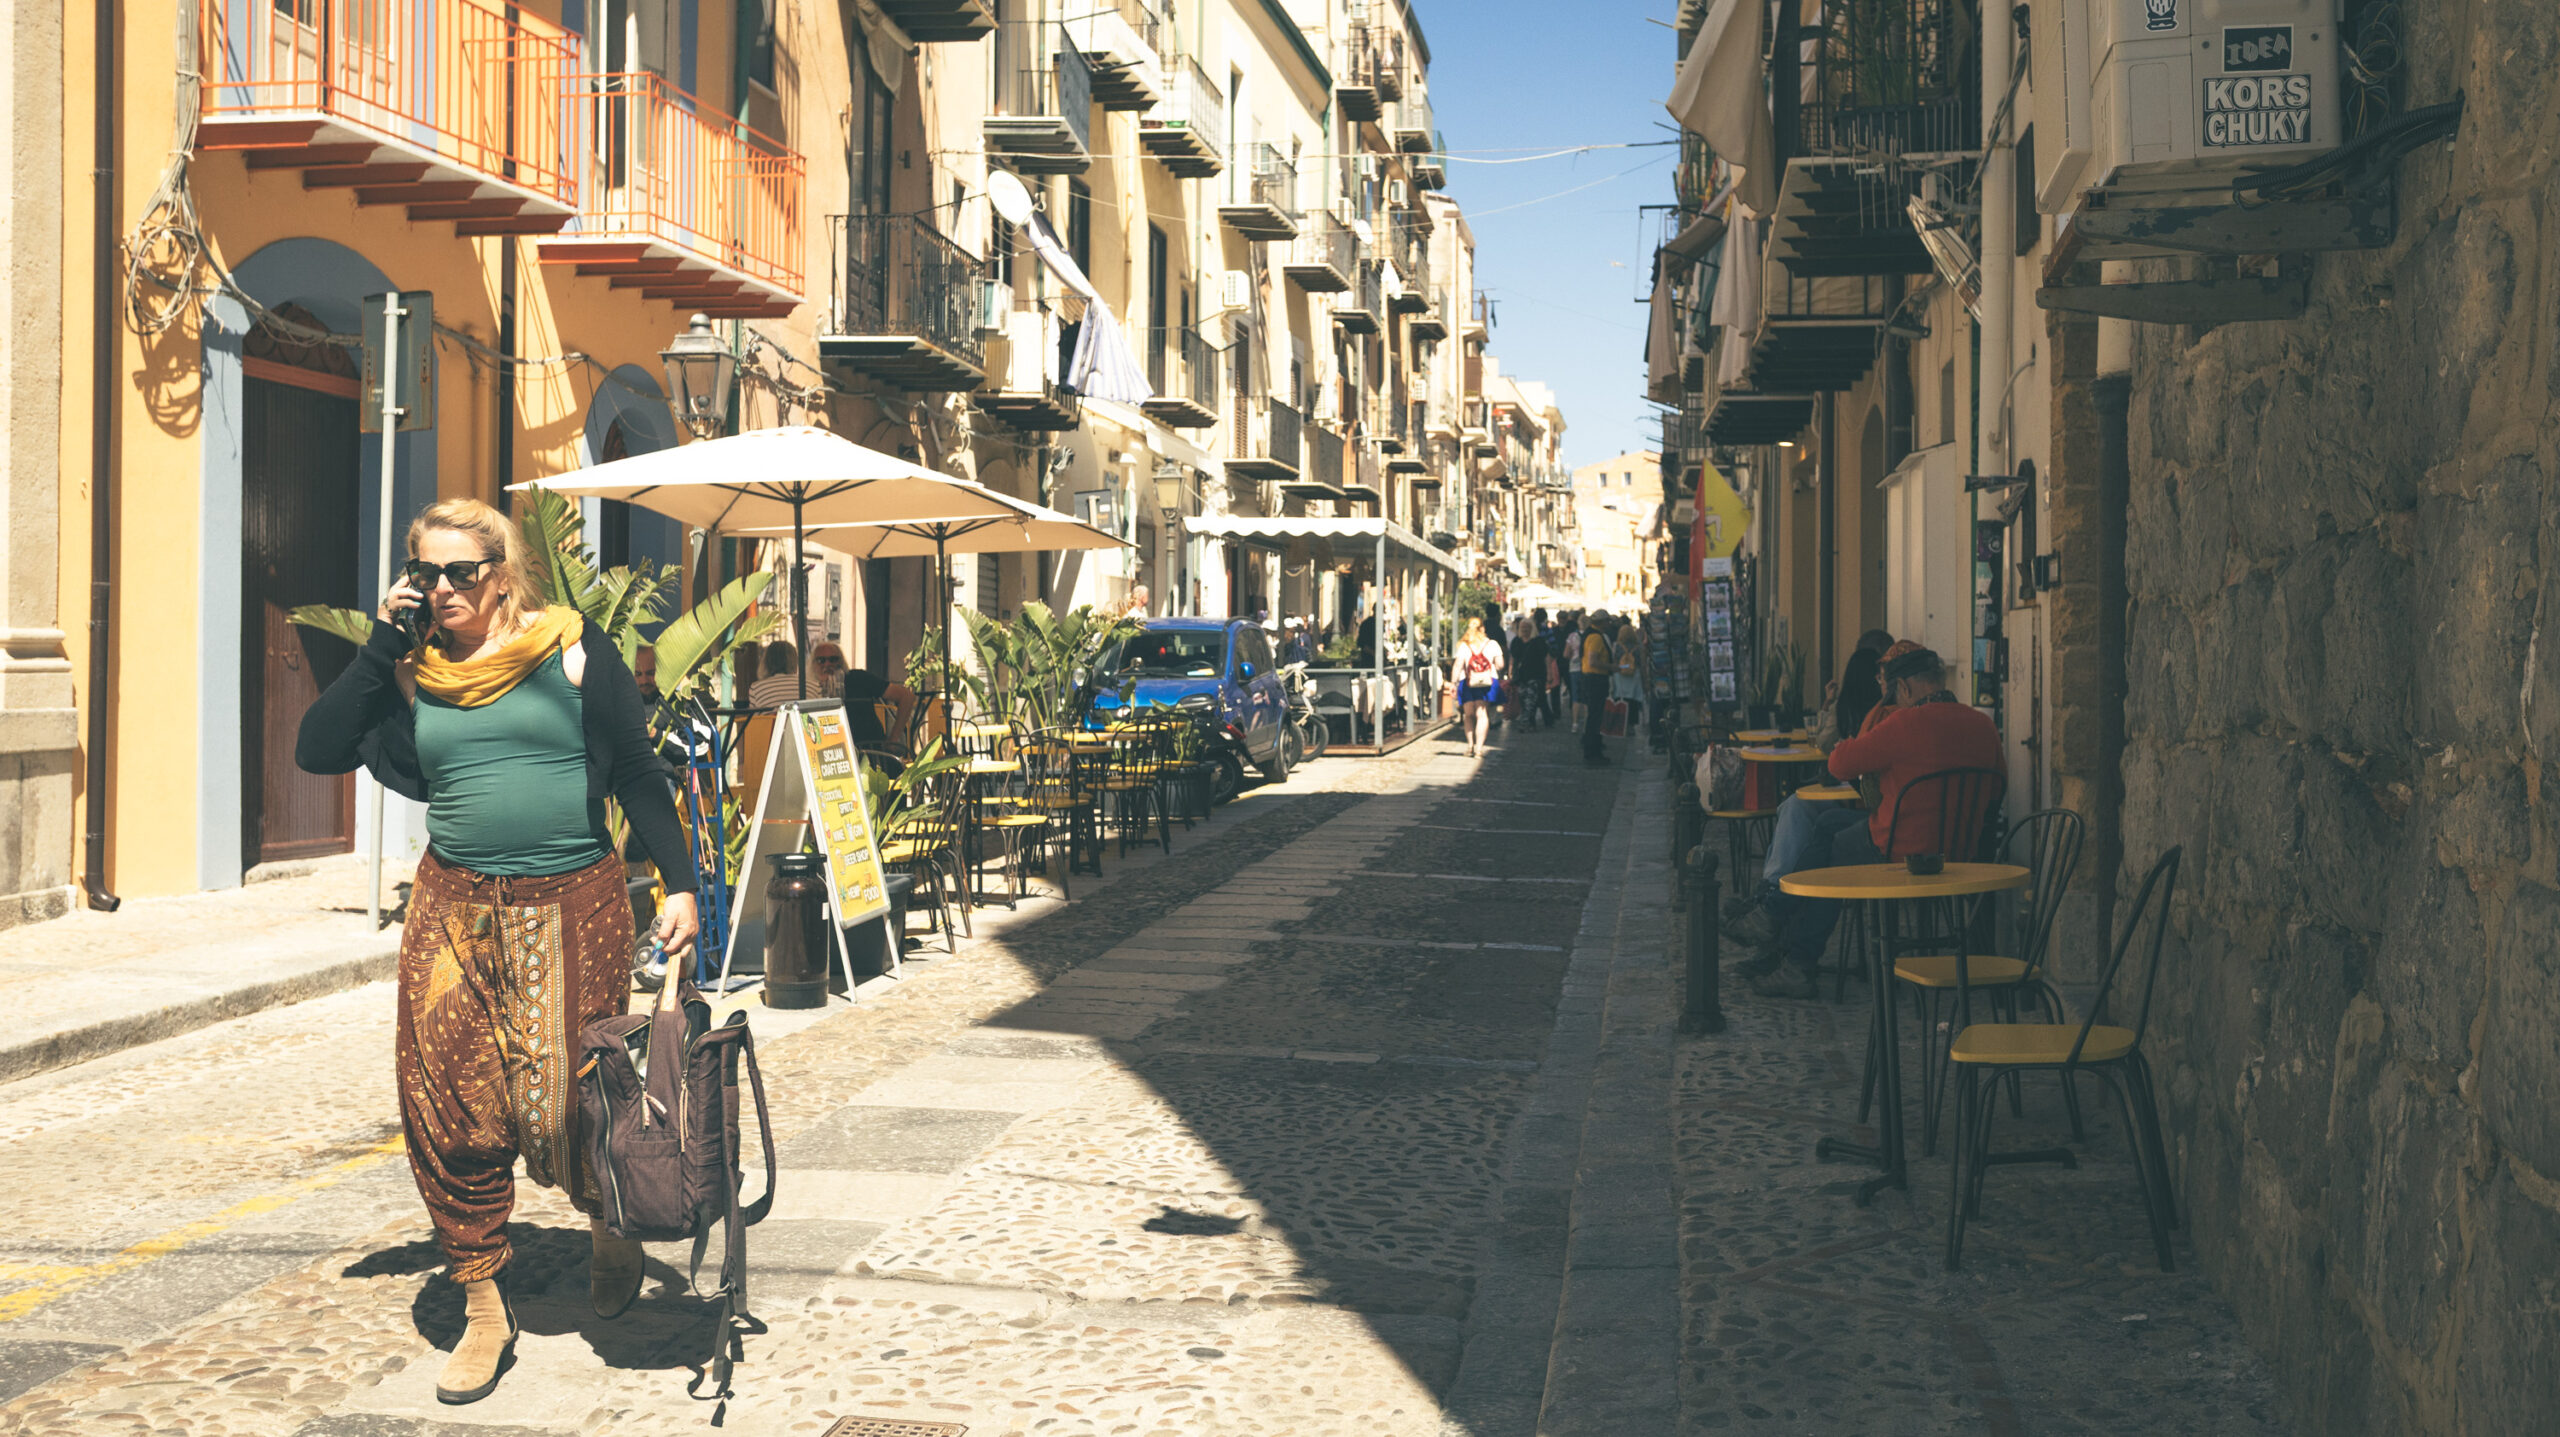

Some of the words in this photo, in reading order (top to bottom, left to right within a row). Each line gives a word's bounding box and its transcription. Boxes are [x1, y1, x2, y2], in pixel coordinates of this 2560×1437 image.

[2226, 33, 2290, 65] IDEA
[2206, 77, 2309, 110] KORS
[2206, 110, 2309, 144] CHUKY
[823, 747, 844, 762] SICILIAN
[821, 762, 837, 777] CRAFT
[837, 760, 851, 774] BEER
[832, 829, 846, 842] WINE
[853, 823, 864, 837] GIN
[844, 852, 857, 866] BEER
[856, 848, 869, 862] SHOP
[863, 885, 880, 903] FOOD
